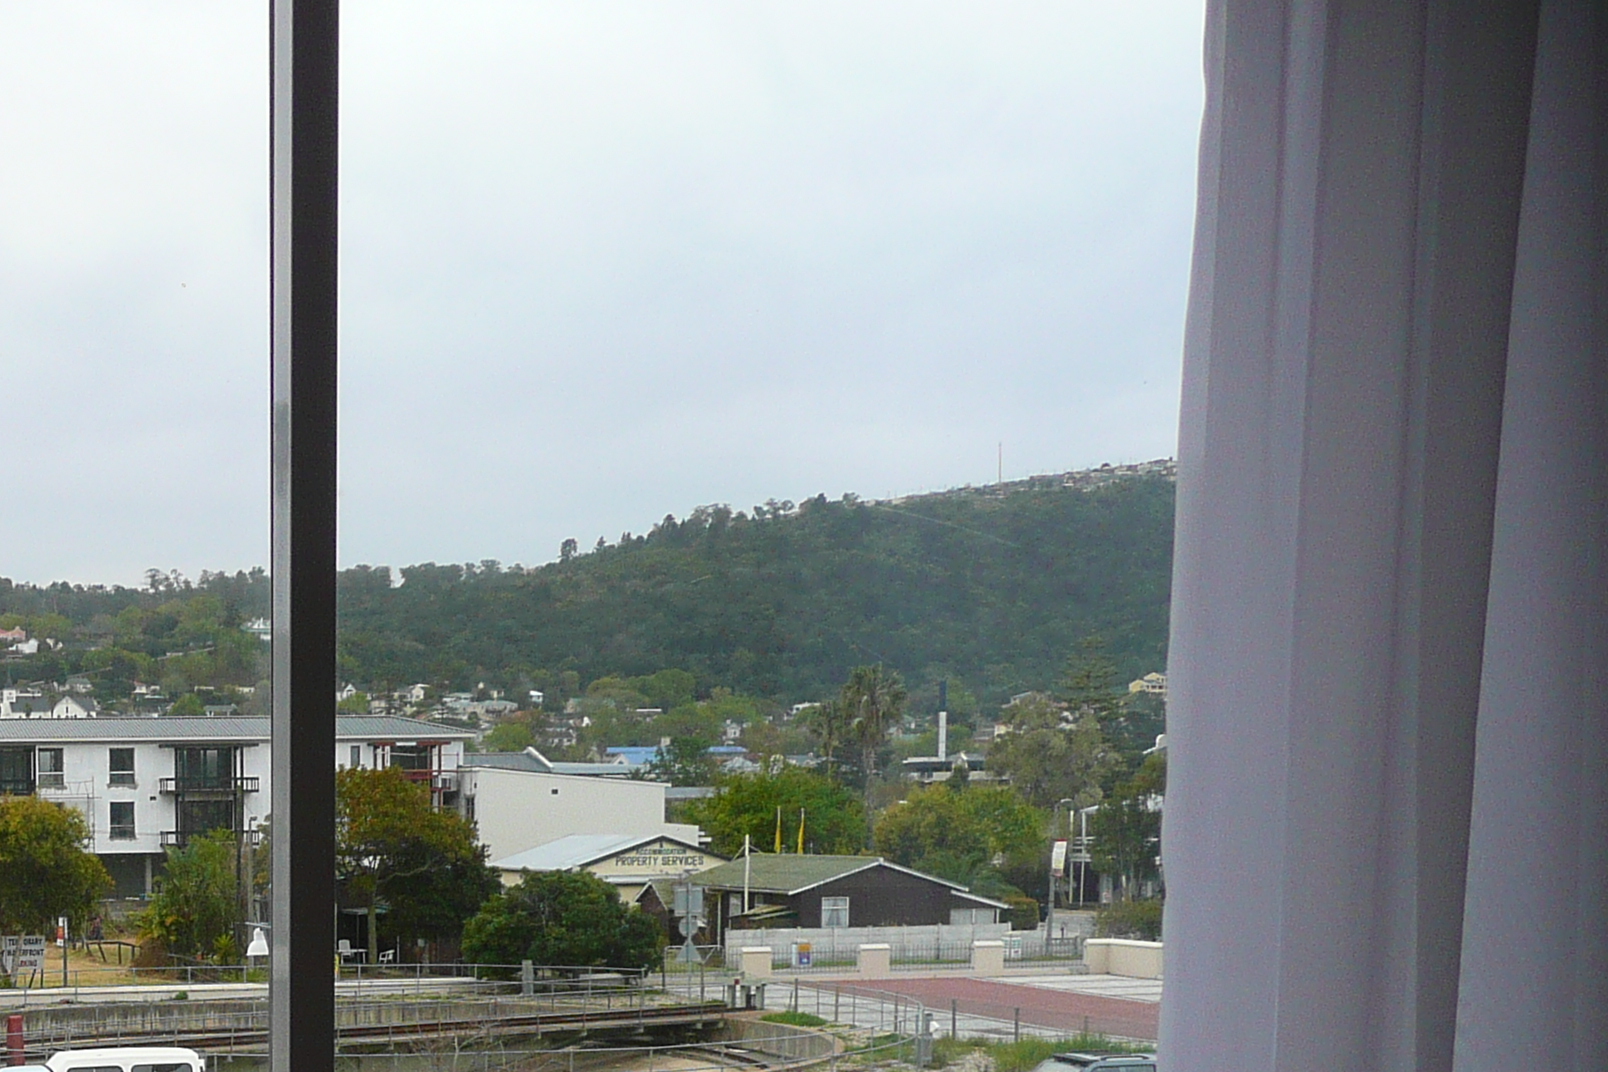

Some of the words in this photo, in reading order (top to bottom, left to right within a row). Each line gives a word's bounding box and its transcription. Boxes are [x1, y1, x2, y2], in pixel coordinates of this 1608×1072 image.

[615, 856, 659, 866] PROPERTY
[661, 855, 704, 866] SERVICES
[8, 938, 43, 946] TEORARY
[7, 949, 44, 957] WAERFRONT
